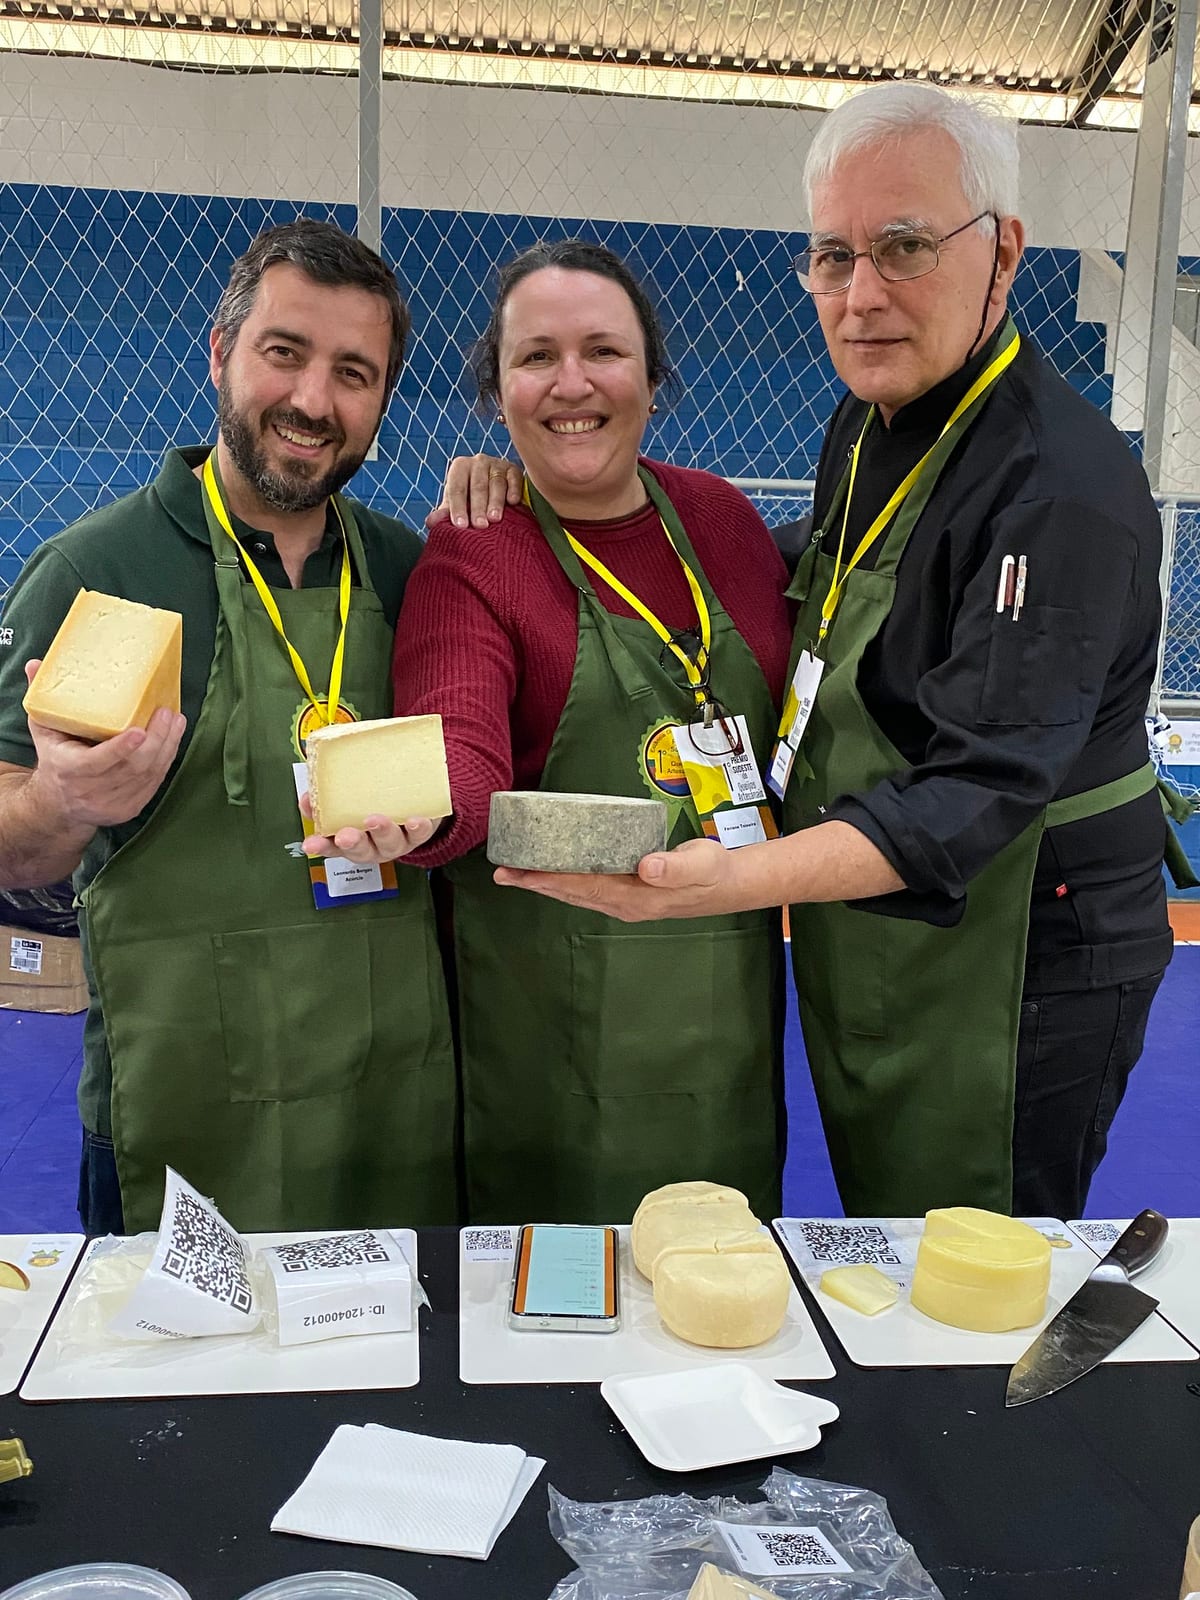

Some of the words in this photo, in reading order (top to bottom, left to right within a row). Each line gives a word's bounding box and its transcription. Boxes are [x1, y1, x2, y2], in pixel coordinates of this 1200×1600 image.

[732, 763, 753, 774] SUDESTE
[368, 1305, 385, 1315] ID:
[303, 1307, 365, 1327] 120400012
